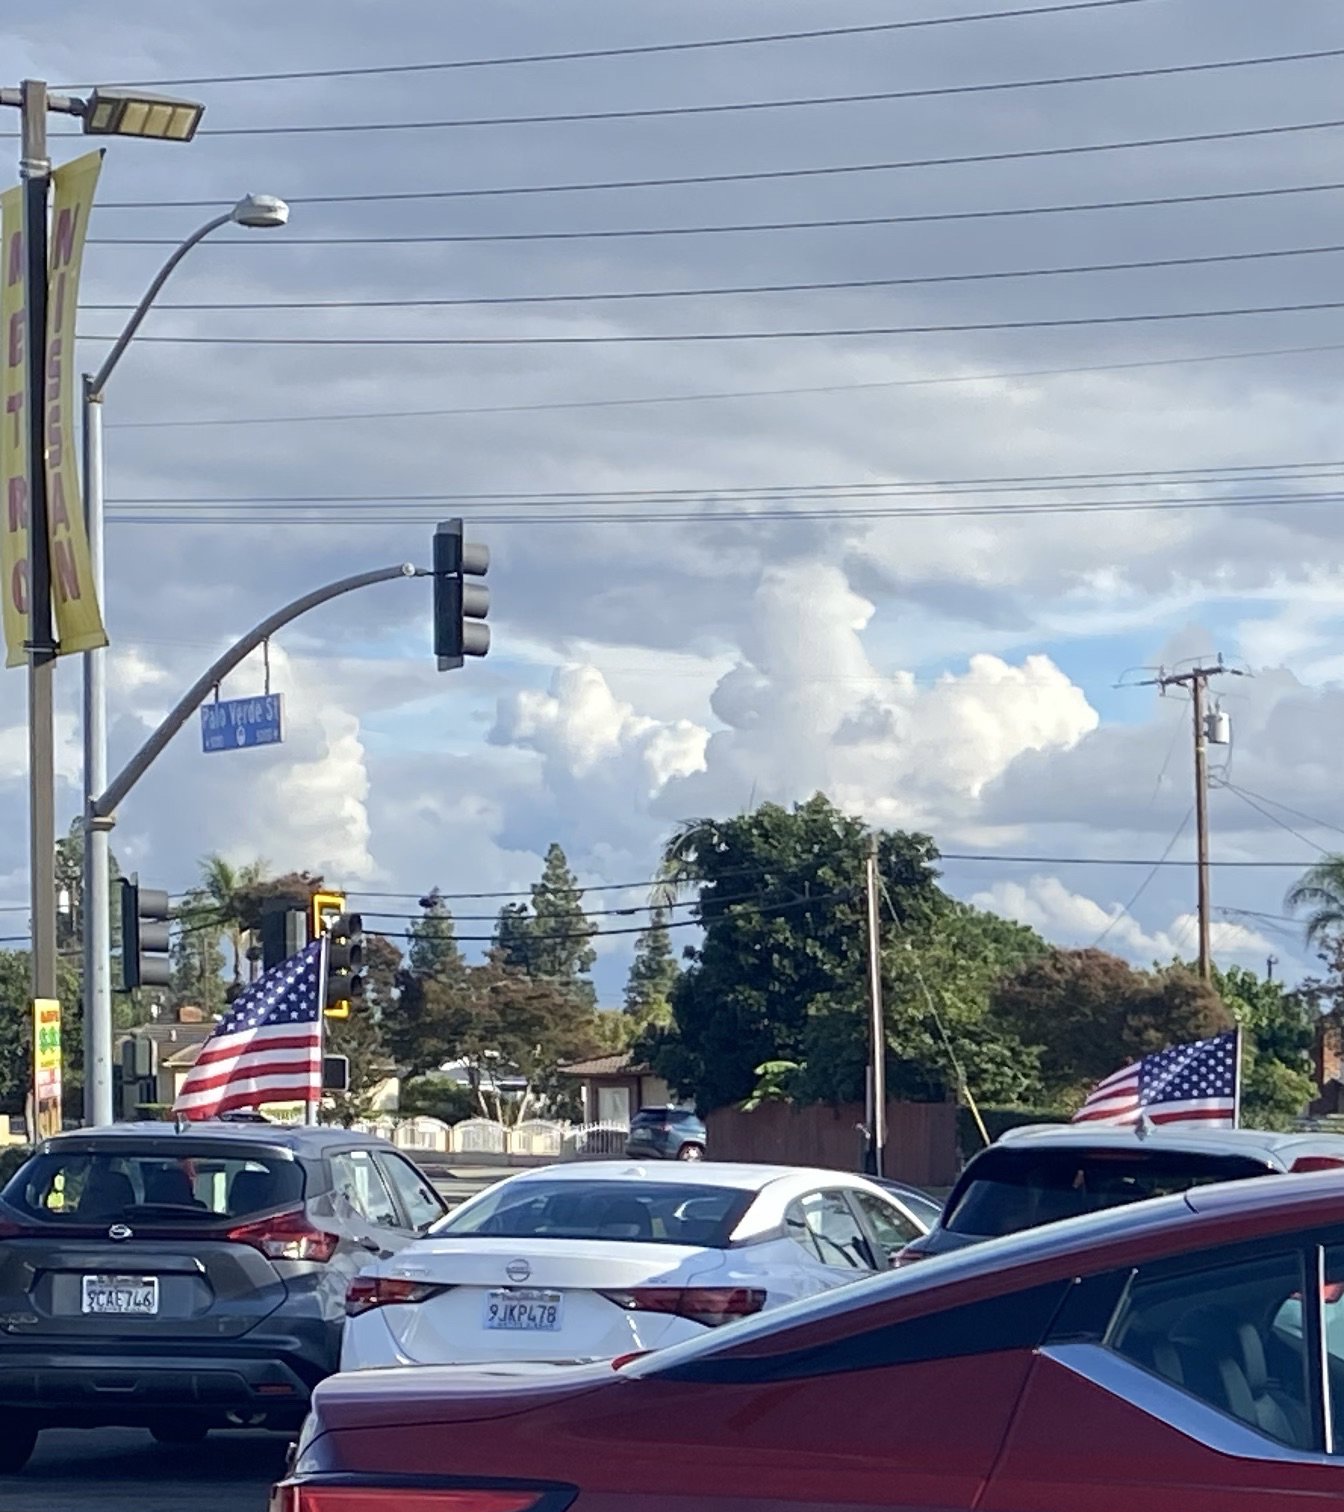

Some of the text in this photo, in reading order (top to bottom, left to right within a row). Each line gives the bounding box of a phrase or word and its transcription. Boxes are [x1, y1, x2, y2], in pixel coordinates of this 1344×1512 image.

[48, 203, 81, 602] NISSAN
[228, 701, 263, 726] Verde
[488, 1304, 557, 1324] 9JKP478
